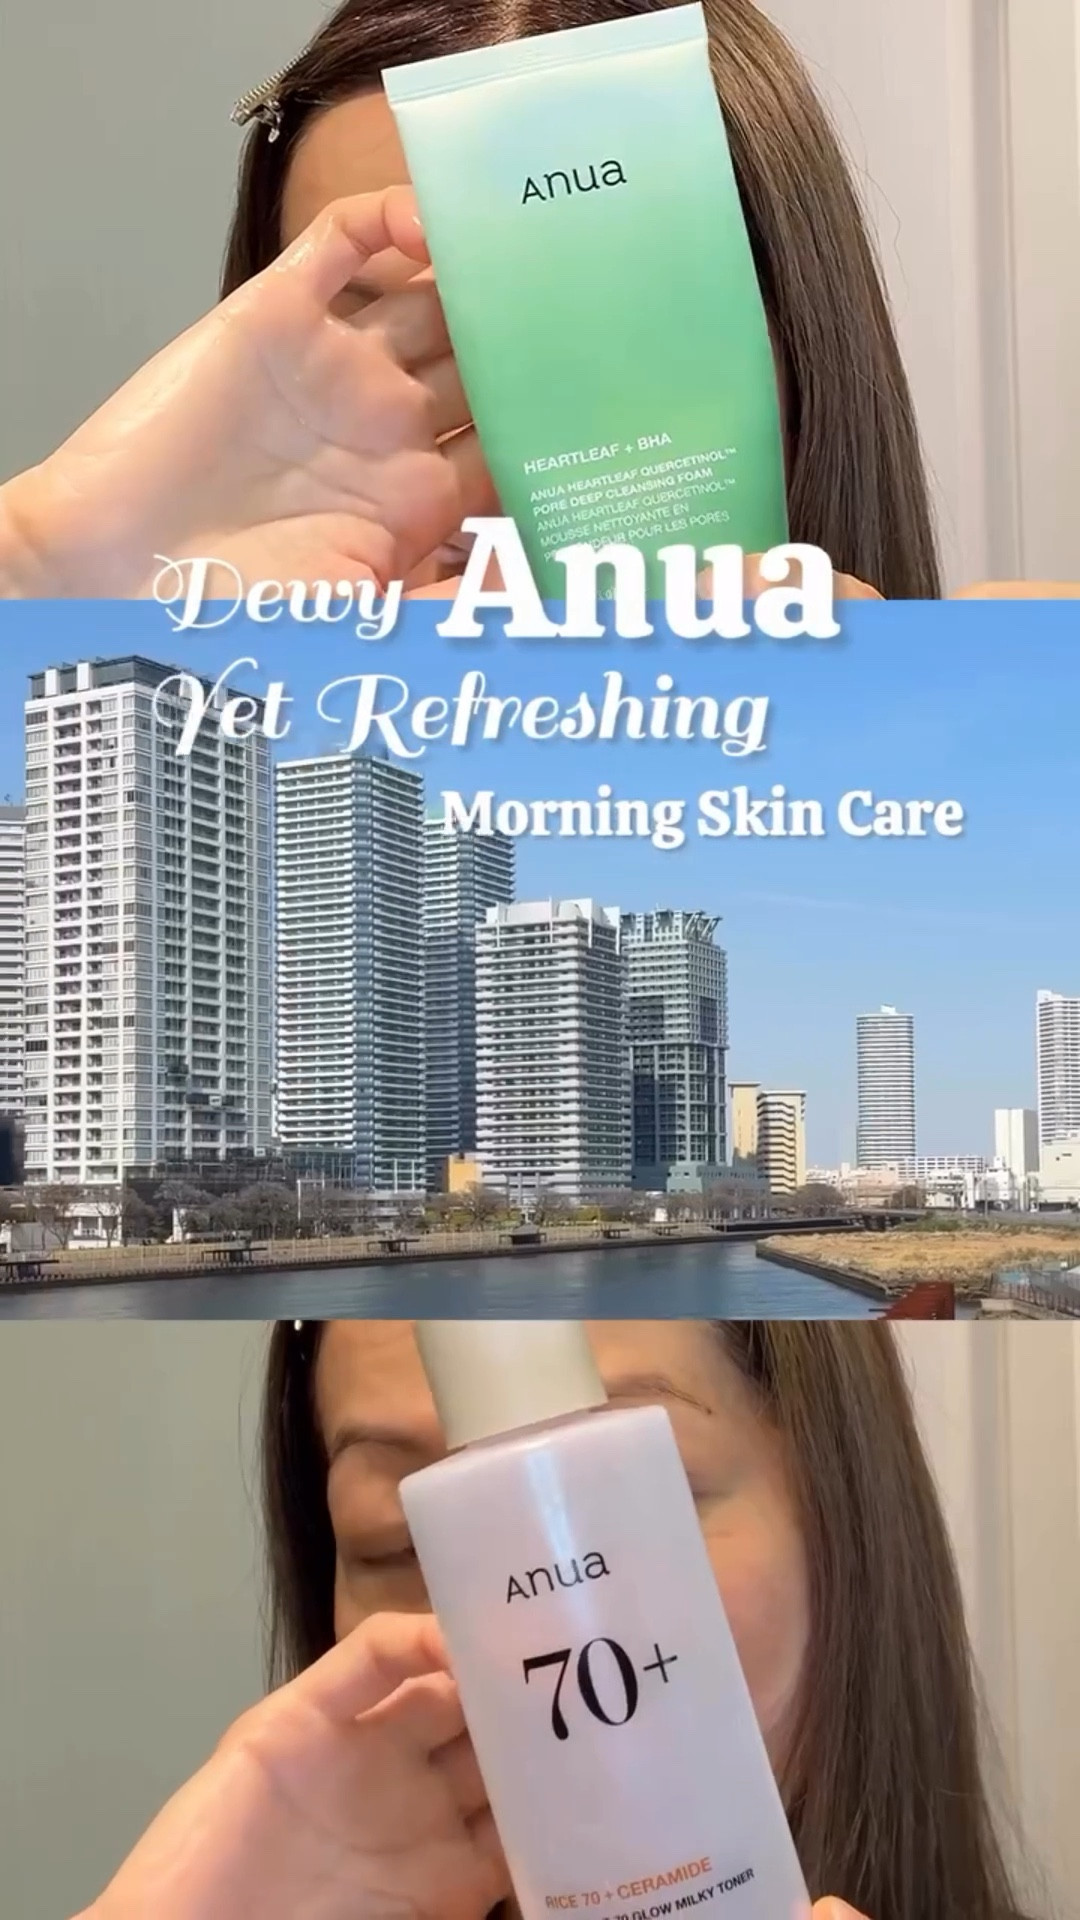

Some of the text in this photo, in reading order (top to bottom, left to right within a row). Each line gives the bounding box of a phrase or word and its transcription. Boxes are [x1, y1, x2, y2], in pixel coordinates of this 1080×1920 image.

[521, 159, 627, 204] Anua
[524, 432, 672, 475] HEARTLEAF + BHA
[530, 485, 565, 503] ANUA
[567, 468, 637, 493] HEARTLEAF
[533, 467, 713, 517] PORE DEEP CLEANSING FOAM
[537, 516, 570, 532] ANUA
[571, 498, 639, 523] HEARTLEAF
[541, 502, 689, 547] MOUSSE NETTOYANTE EN
[628, 522, 663, 541] POUR
[665, 516, 688, 532] LES
[690, 510, 730, 527] PORES
[507, 1551, 610, 1603] Anua
[545, 1856, 712, 1909] RICE 70 + CERAMIDE
[675, 1886, 715, 1911] MILKY
[717, 1868, 756, 1894] TONER
